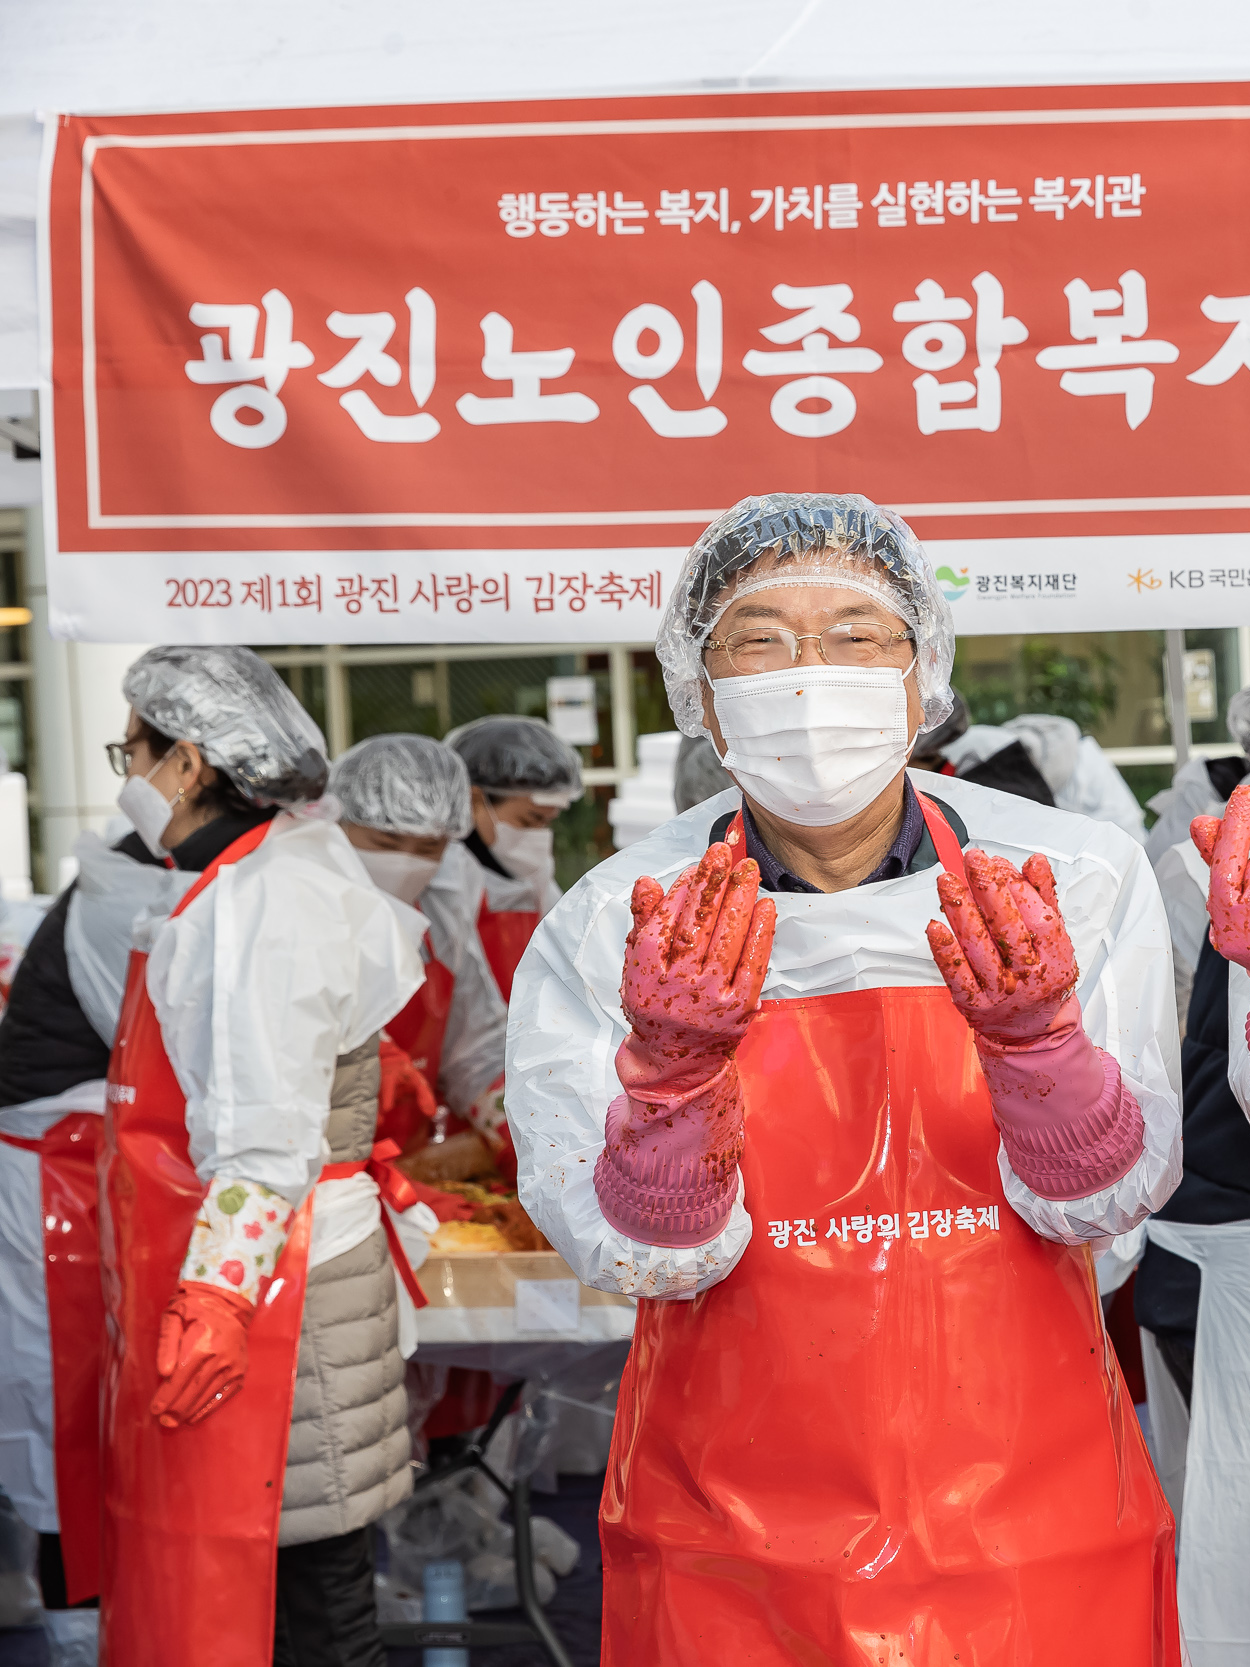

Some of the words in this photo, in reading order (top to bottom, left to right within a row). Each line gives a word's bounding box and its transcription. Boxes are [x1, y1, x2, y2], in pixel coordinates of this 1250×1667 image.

[497, 190, 650, 239] 행동하는
[654, 187, 742, 235] 복지,
[749, 184, 864, 231] 가치를
[870, 178, 1023, 228] 실현하는
[1028, 172, 1147, 221] 복지관
[164, 577, 233, 608] 2023
[240, 574, 323, 613] 제1회
[333, 573, 401, 614] 광진
[408, 572, 511, 613] 사랑의
[524, 571, 662, 613] 김장축제
[976, 573, 1077, 593] 광진복지재단
[767, 1217, 818, 1249] 광진
[824, 1212, 901, 1244] 사랑의
[906, 1205, 1001, 1239] 김장축제
